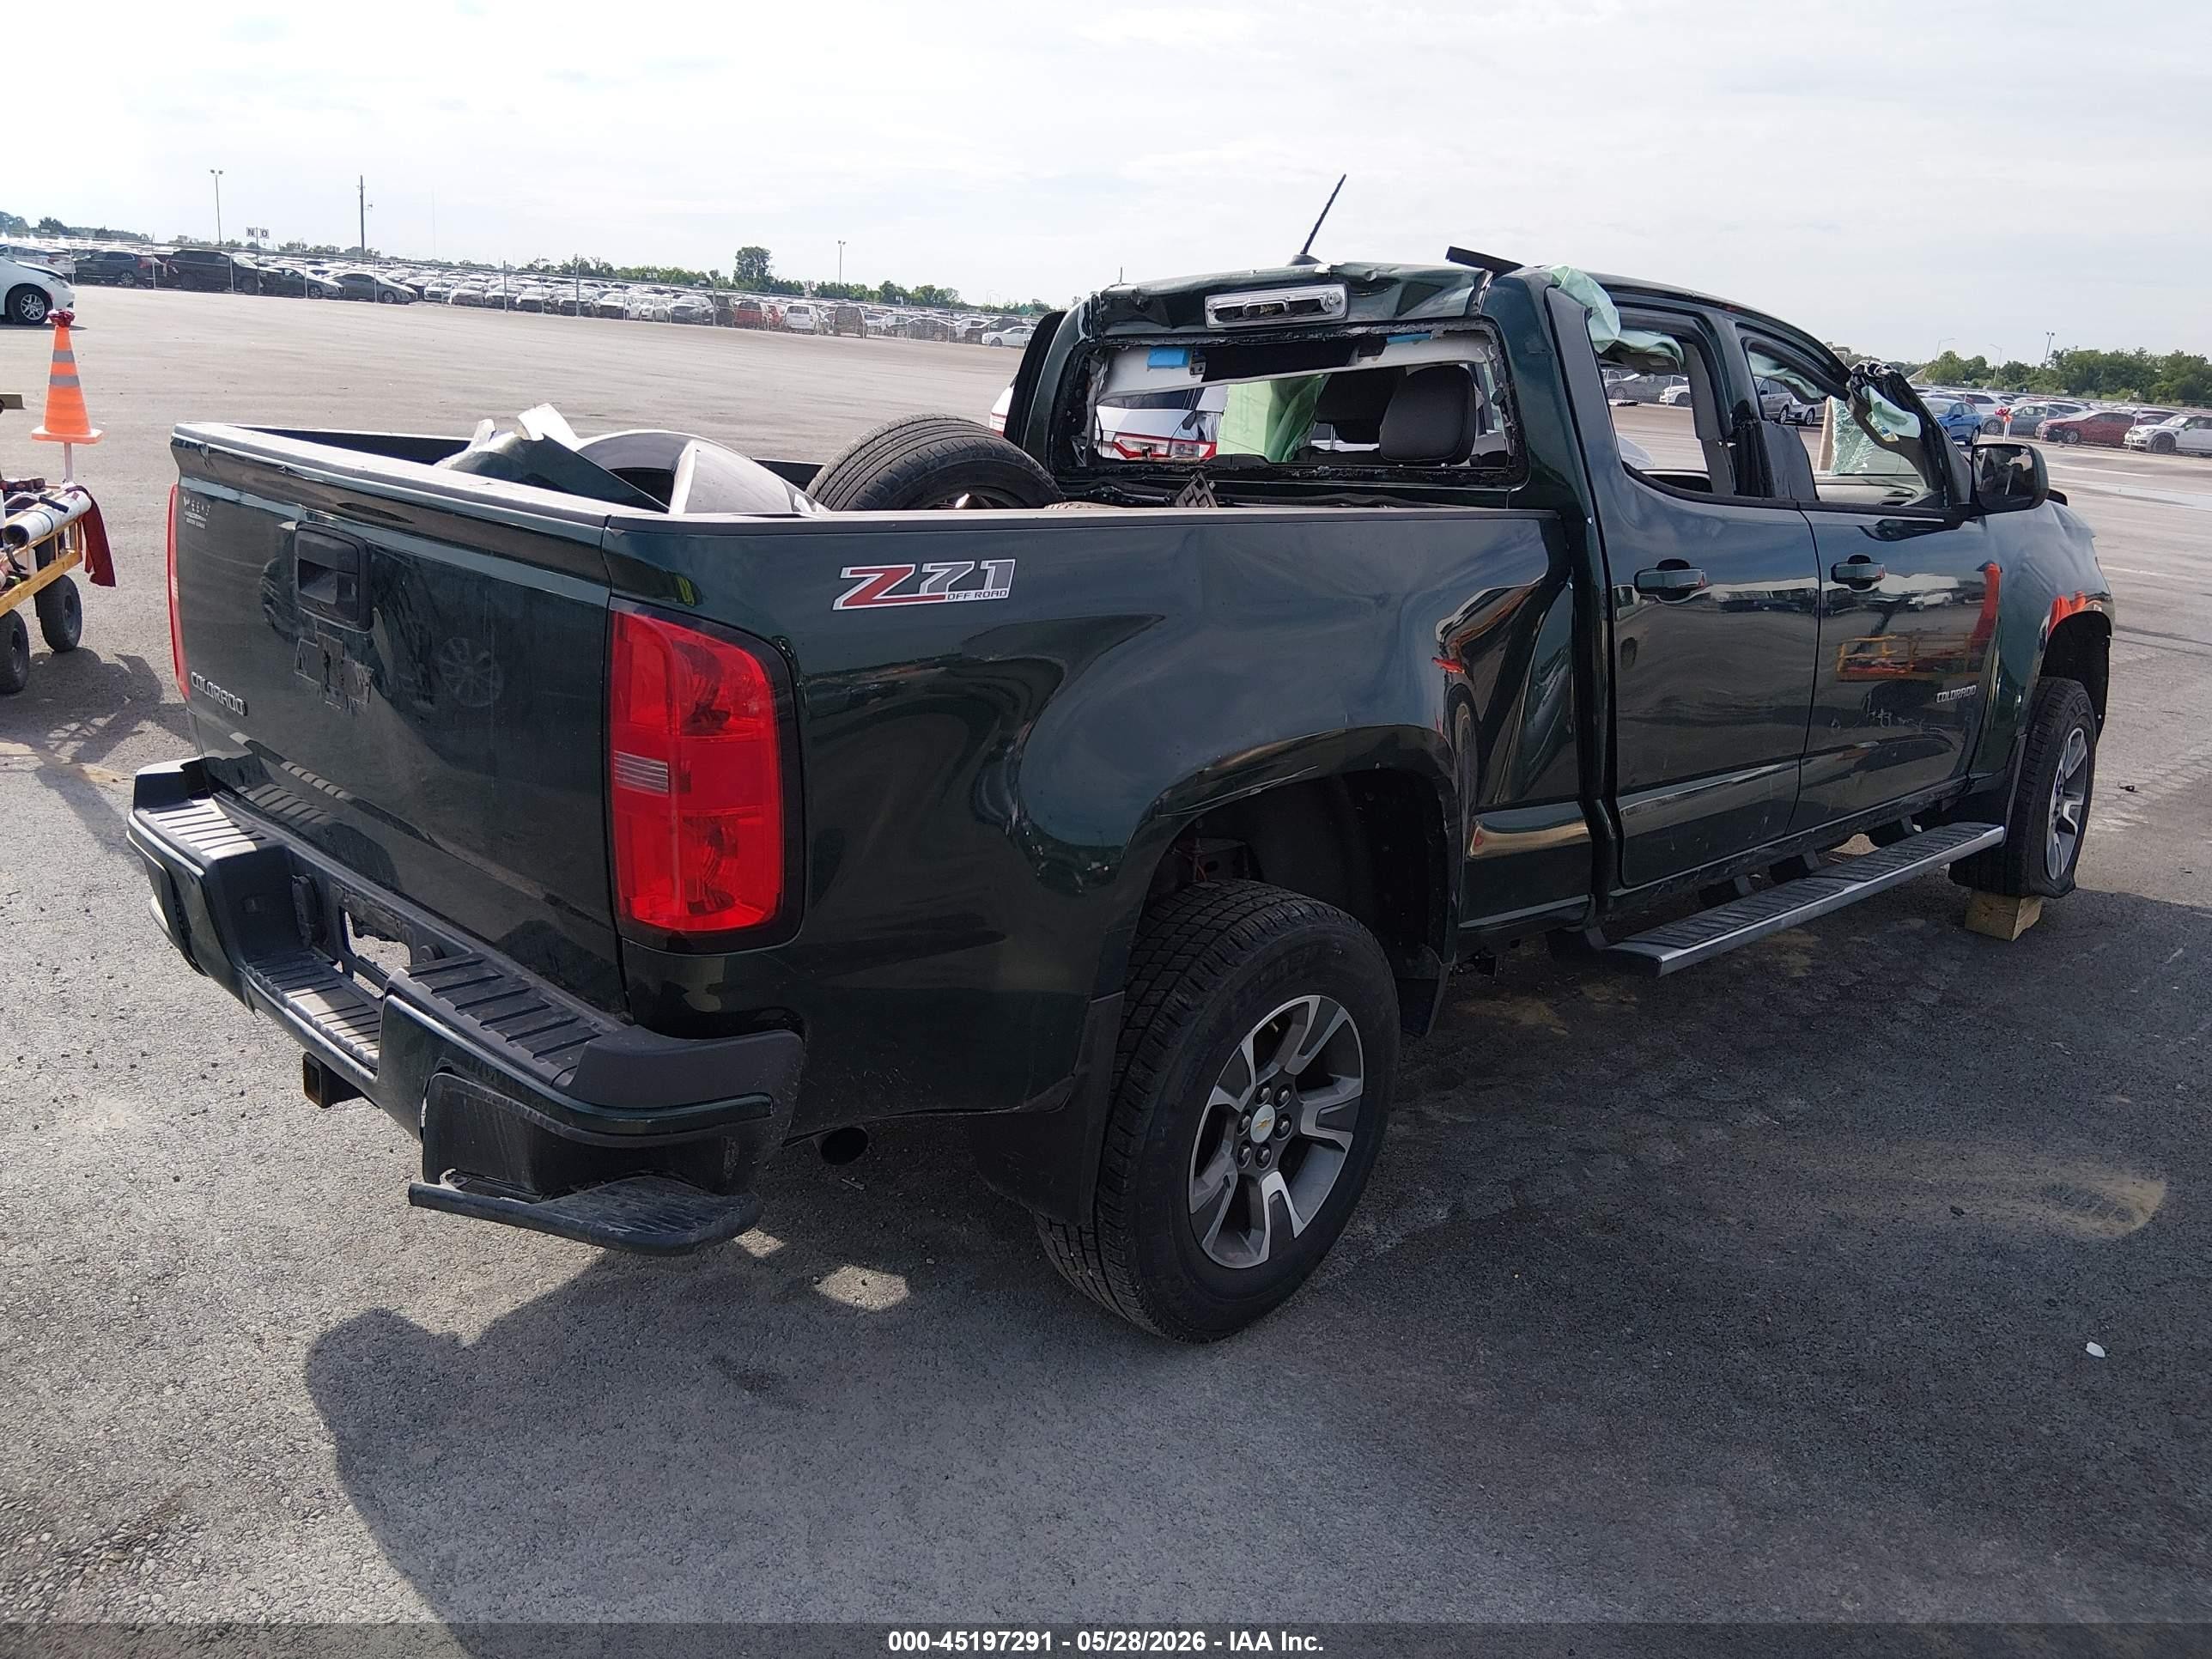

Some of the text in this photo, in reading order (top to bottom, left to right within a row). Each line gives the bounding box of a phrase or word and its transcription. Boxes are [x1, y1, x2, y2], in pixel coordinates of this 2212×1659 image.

[832, 558, 1016, 611] Z71
[947, 589, 1008, 601] OFF ROAD
[191, 671, 247, 716] COLORADO
[1936, 684, 1977, 703] COLORADO
